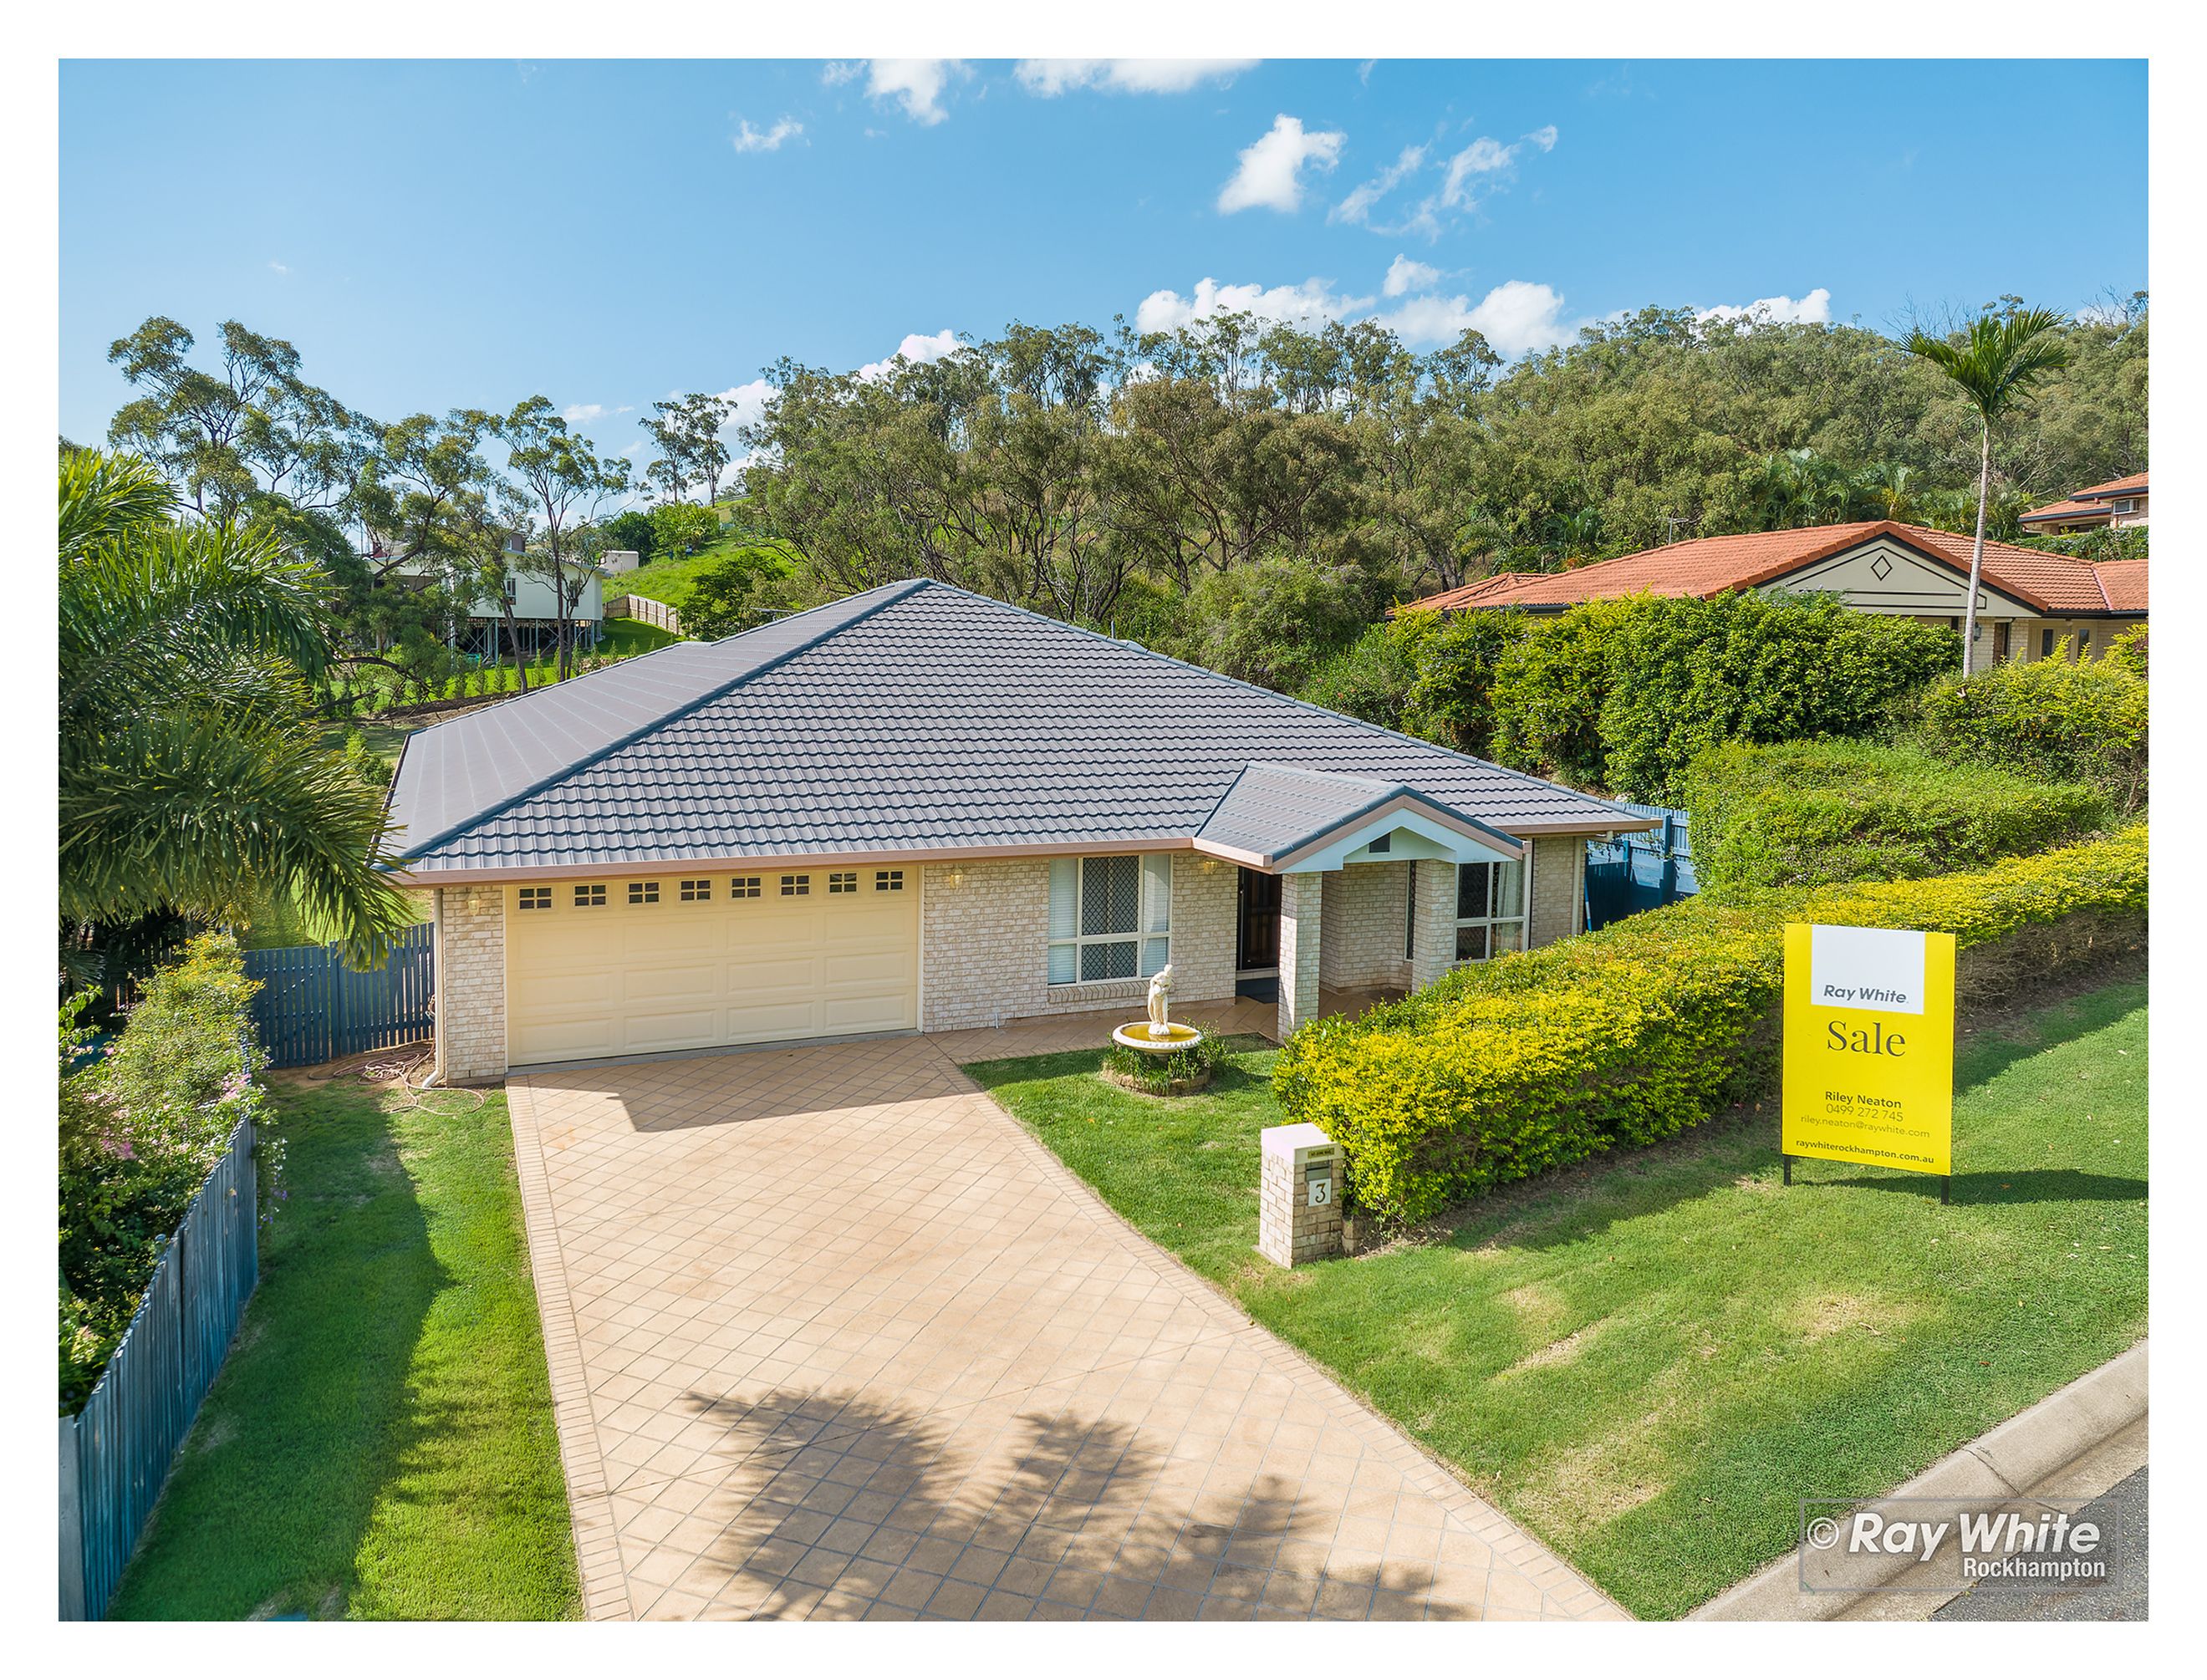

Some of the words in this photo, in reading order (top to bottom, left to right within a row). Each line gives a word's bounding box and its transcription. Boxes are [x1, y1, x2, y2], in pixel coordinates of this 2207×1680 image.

[1823, 985, 1856, 1001] Ray
[1859, 987, 1907, 1003] White
[1827, 1020, 1906, 1056] Sale
[1825, 1091, 1853, 1105] Riley
[1857, 1094, 1902, 1108] Neaton
[1826, 1103, 1854, 1115] 0499
[1858, 1107, 1878, 1118] 272
[1882, 1110, 1904, 1122] 745
[1801, 1115, 1930, 1138] riley.neaton@raywhite.com
[1796, 1139, 1934, 1163] raywhiterockhampton.com.au
[1315, 1183, 1326, 1203] 3
